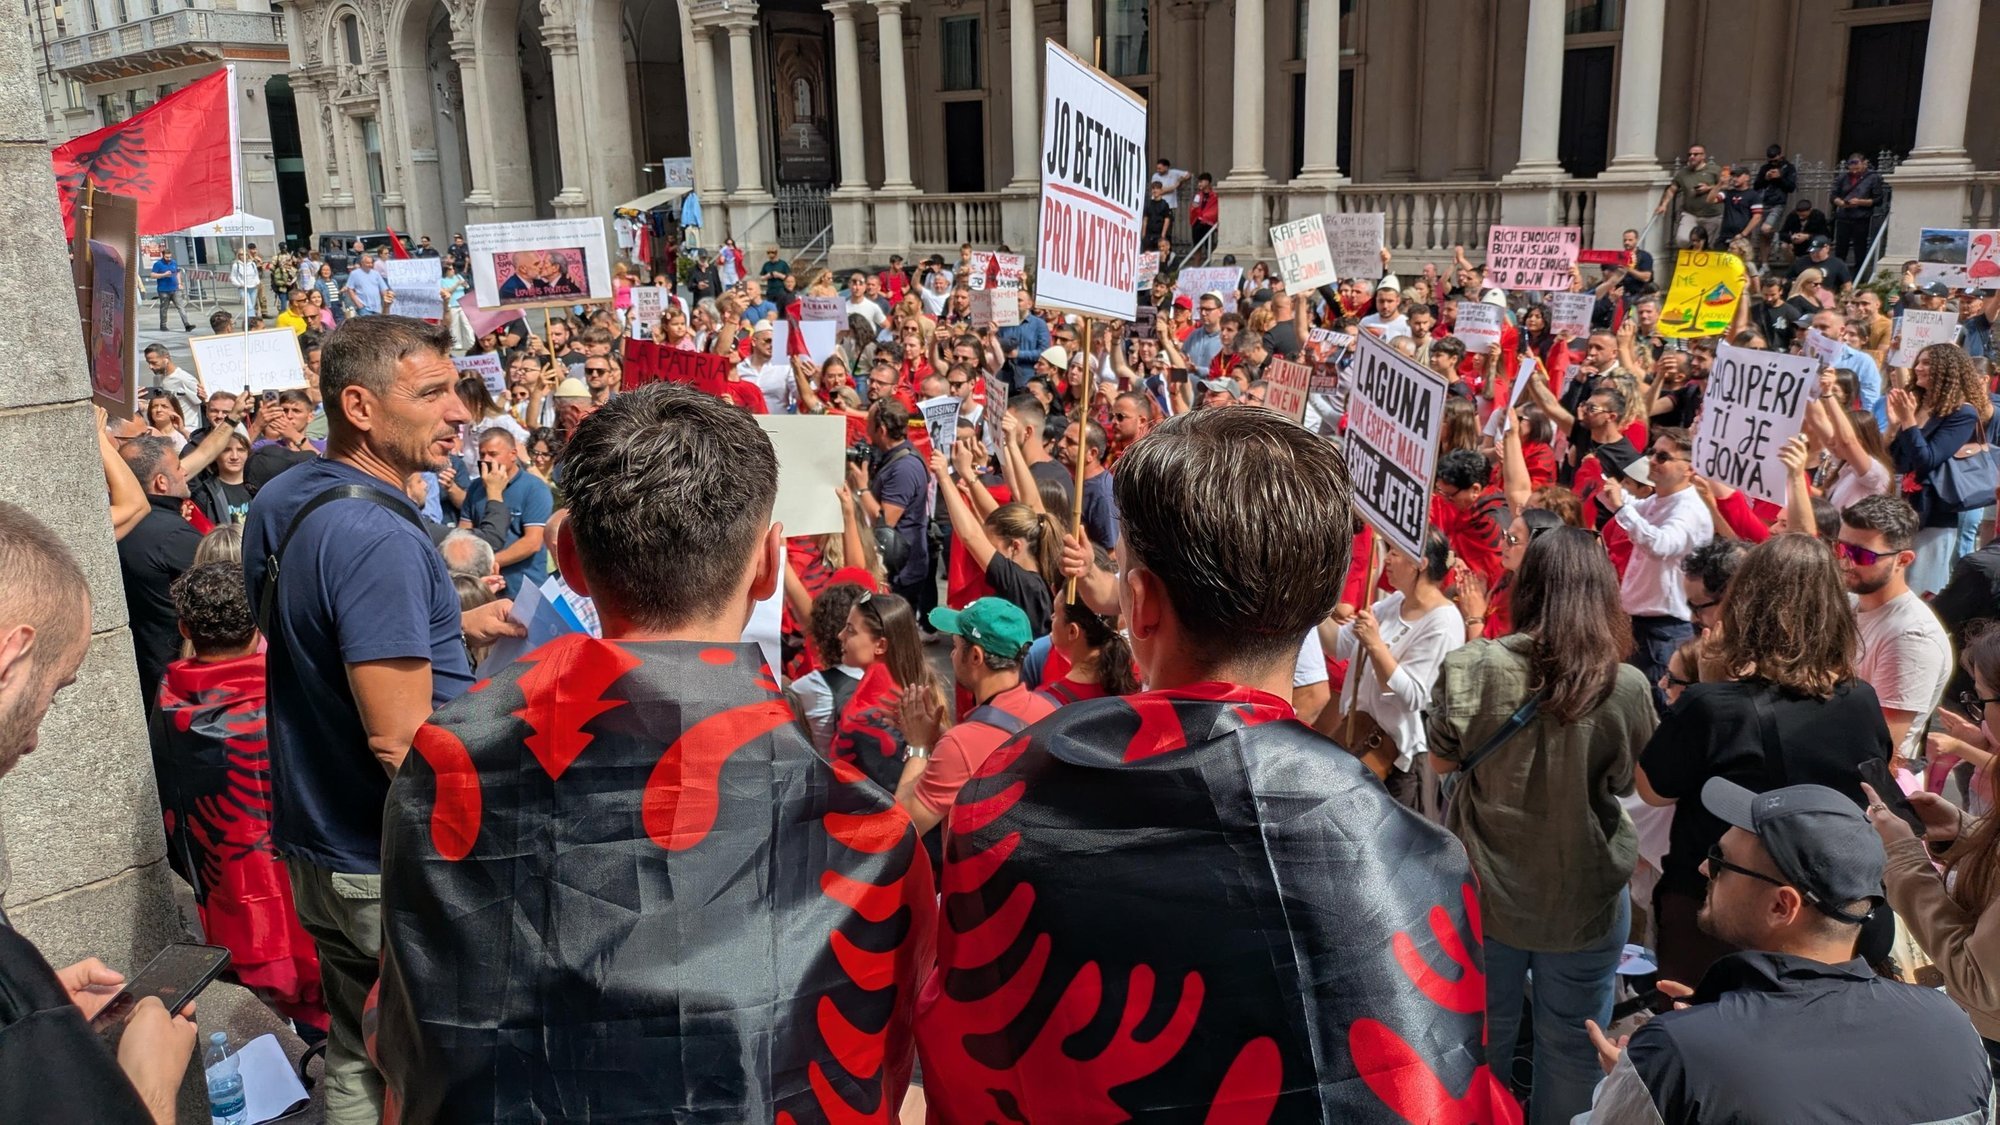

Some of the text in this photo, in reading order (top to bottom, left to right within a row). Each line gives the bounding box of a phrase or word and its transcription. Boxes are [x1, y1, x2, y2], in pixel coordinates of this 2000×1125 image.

[1046, 97, 1142, 211] JO BETONIT!
[1271, 216, 1321, 243] KAPENI
[1521, 231, 1561, 243] ENOUGH
[1565, 232, 1577, 243] TO
[1041, 195, 1138, 294] PRO NATYRËS!
[1494, 257, 1517, 269] NOT
[1680, 252, 1709, 268] JO
[1493, 272, 1507, 283] TO
[1515, 272, 1543, 285] OWN
[803, 302, 838, 311] ALBANIA
[207, 344, 233, 360] THE
[461, 358, 496, 369] FLAMINGO
[658, 347, 728, 382] PATRIA
[1356, 346, 1431, 441] LAGUNA
[927, 403, 957, 418] MISSING
[1351, 395, 1365, 433] NUK
[1365, 403, 1397, 458] ËSHTË
[1738, 415, 1772, 461] JE
[1349, 433, 1421, 538] ËSHTË JETË!
